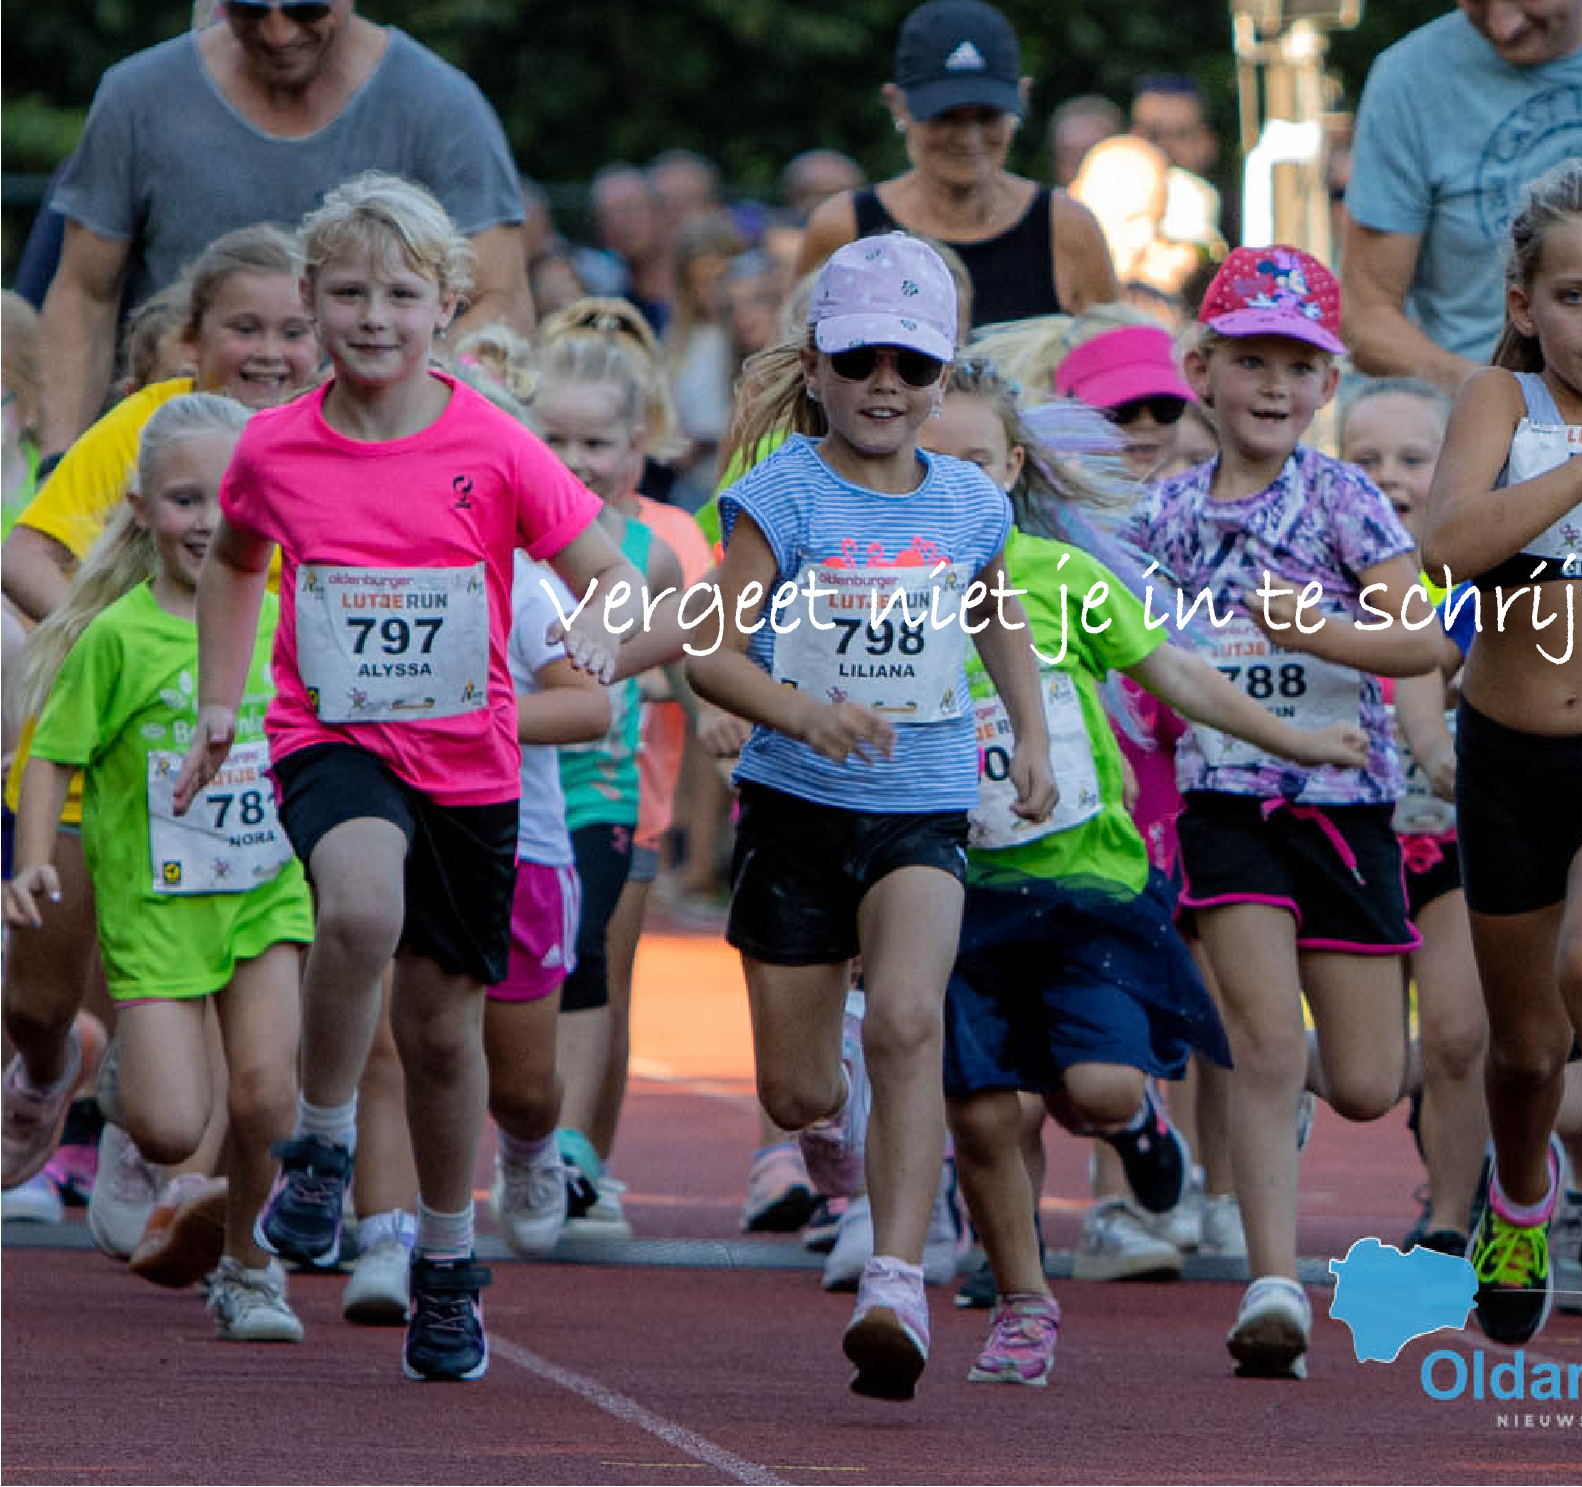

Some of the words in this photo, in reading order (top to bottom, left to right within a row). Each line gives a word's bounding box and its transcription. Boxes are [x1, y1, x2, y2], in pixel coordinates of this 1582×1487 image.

[346, 616, 443, 655] 797
[831, 617, 924, 656] 798
[358, 662, 432, 678] ALYSSA
[839, 663, 915, 678] LILIANA
[229, 830, 276, 847] NORA
